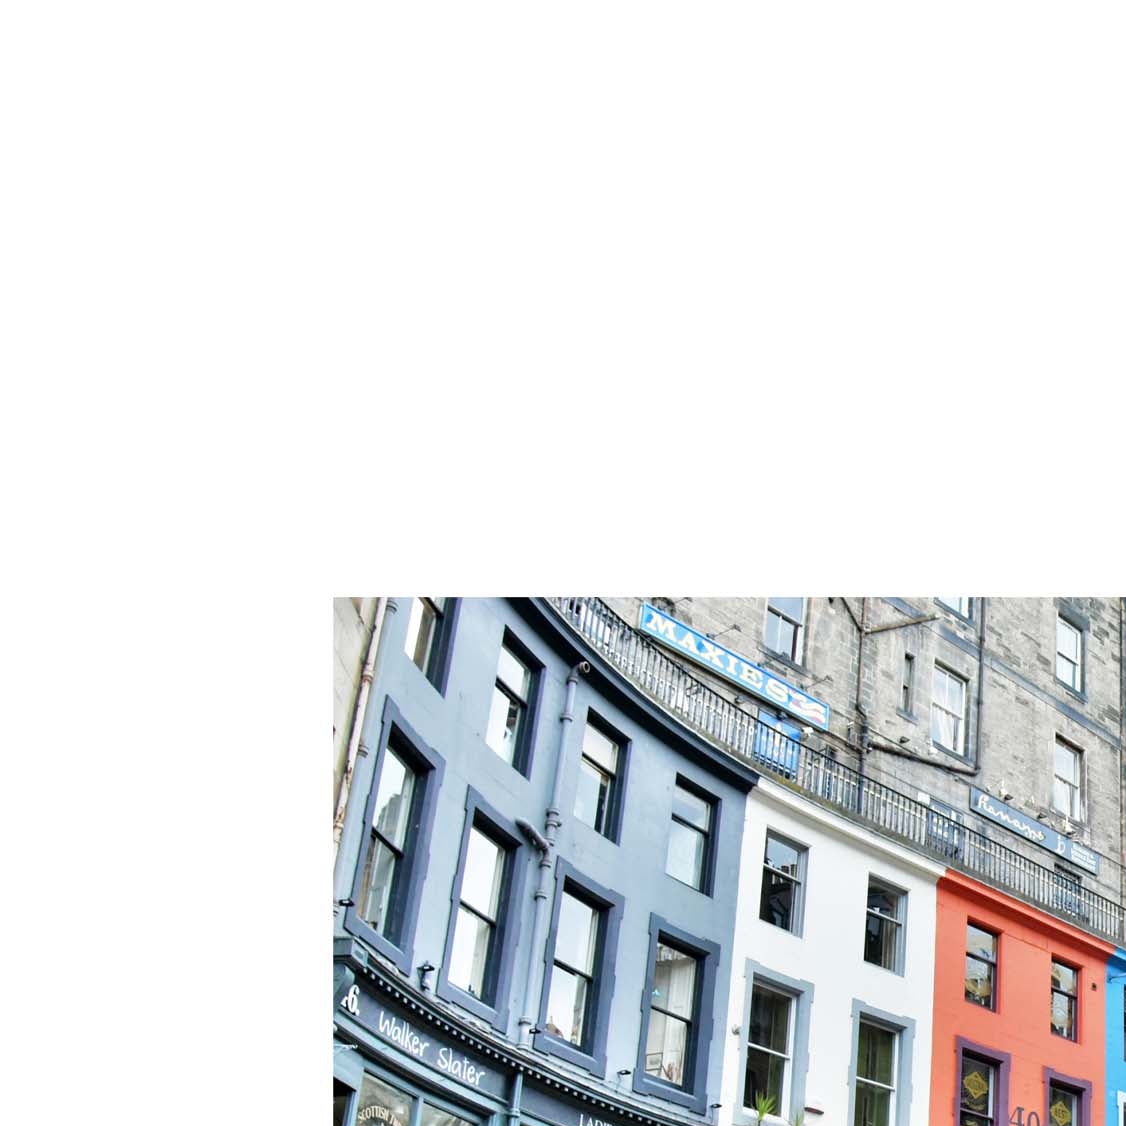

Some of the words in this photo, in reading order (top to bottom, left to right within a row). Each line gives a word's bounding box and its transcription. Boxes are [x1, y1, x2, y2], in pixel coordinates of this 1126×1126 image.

[378, 1010, 430, 1057] Walker
[437, 1047, 486, 1086] Slater
[358, 1105, 390, 1123] SCOTTISH
